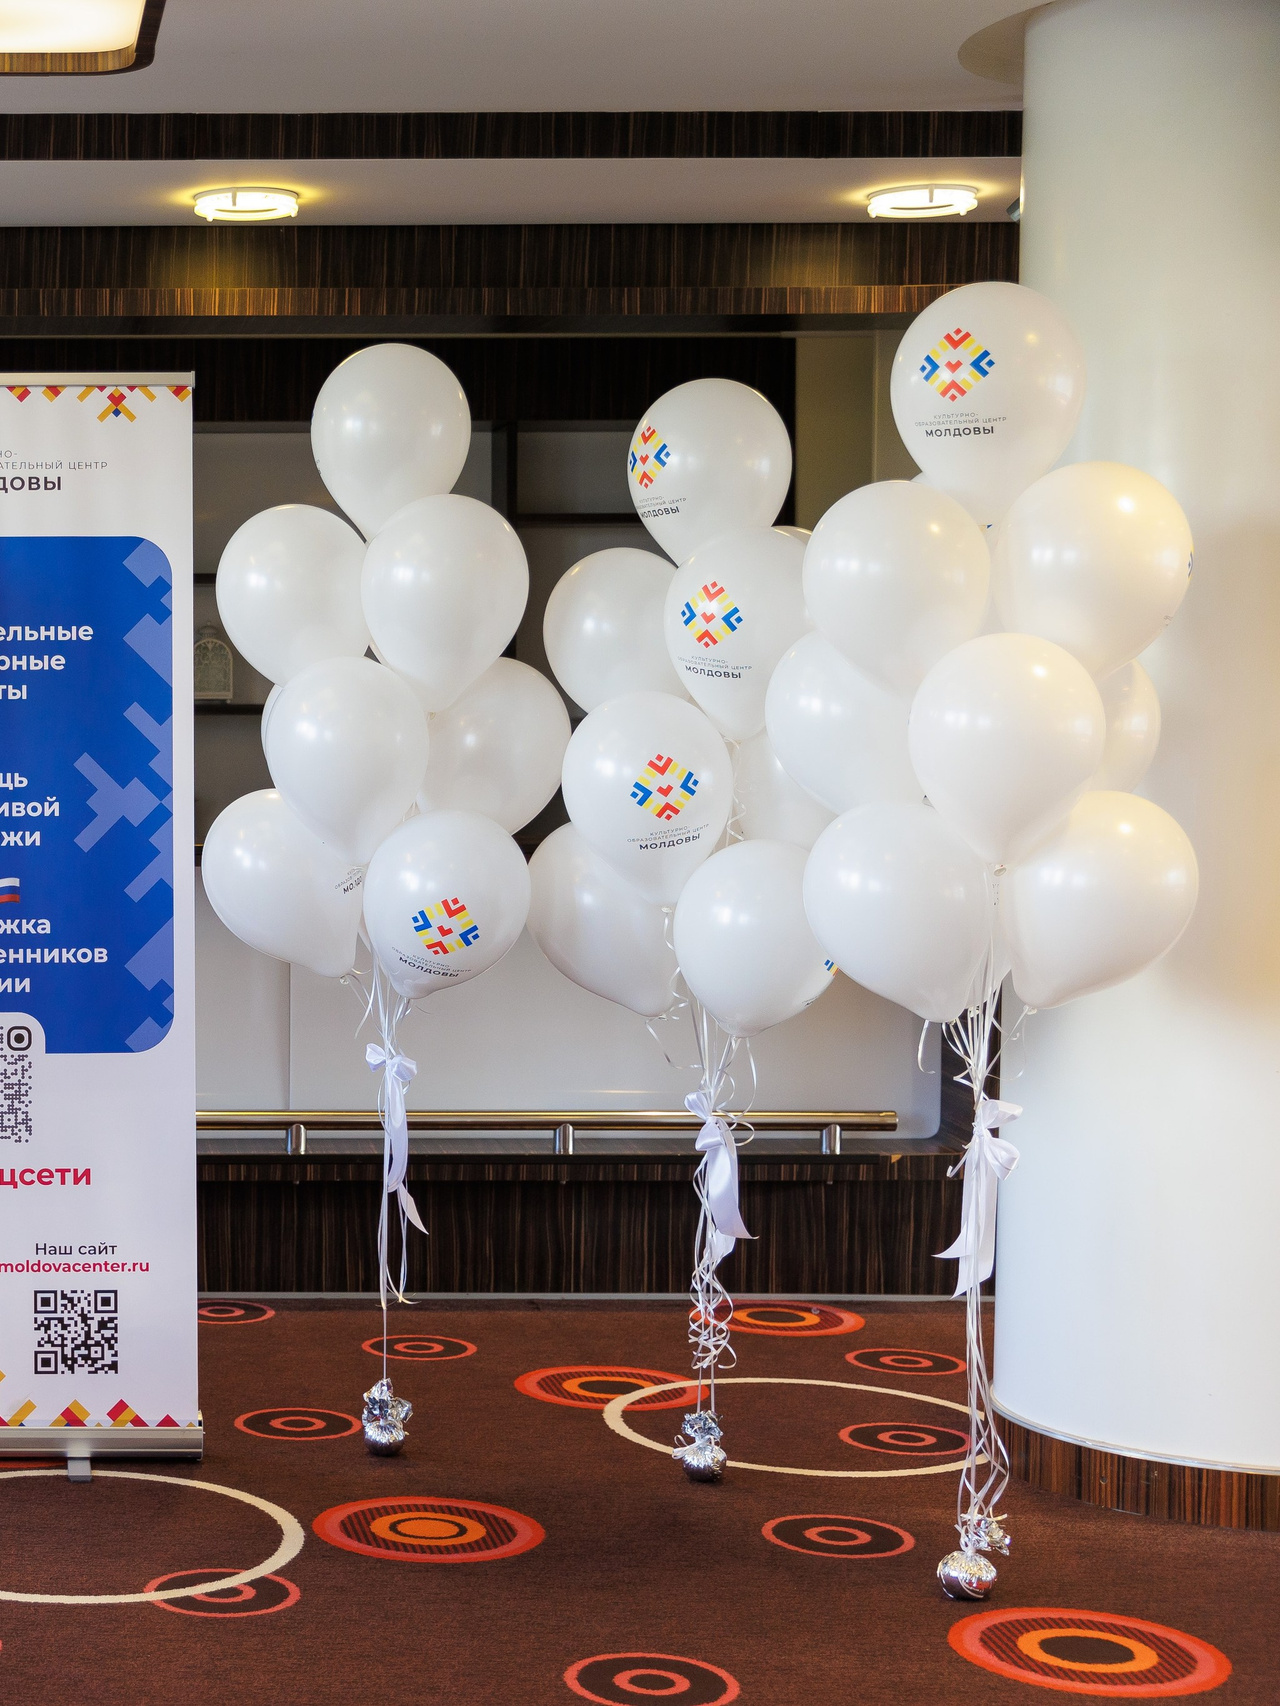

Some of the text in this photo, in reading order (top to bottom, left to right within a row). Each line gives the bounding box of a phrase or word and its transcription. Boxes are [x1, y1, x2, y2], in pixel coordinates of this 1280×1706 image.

[914, 416, 1007, 427] ОБРАЗОВАТЕЛЬНЫЙ ЦЕНТР
[925, 426, 994, 437] МОЛДОВЫ
[68, 461, 108, 471] ЦЕНТР
[668, 497, 687, 505] ЦЕНТР
[685, 665, 741, 678] МОЛДОВЫ
[627, 823, 709, 843] ОБРАЗОВАТЕЛЬНЫЙ ЦЕНТР
[639, 833, 701, 850] МОЛДОВЫ
[399, 956, 459, 978] МОЛДОВЫ
[35, 1241, 118, 1256] Наш сайт
